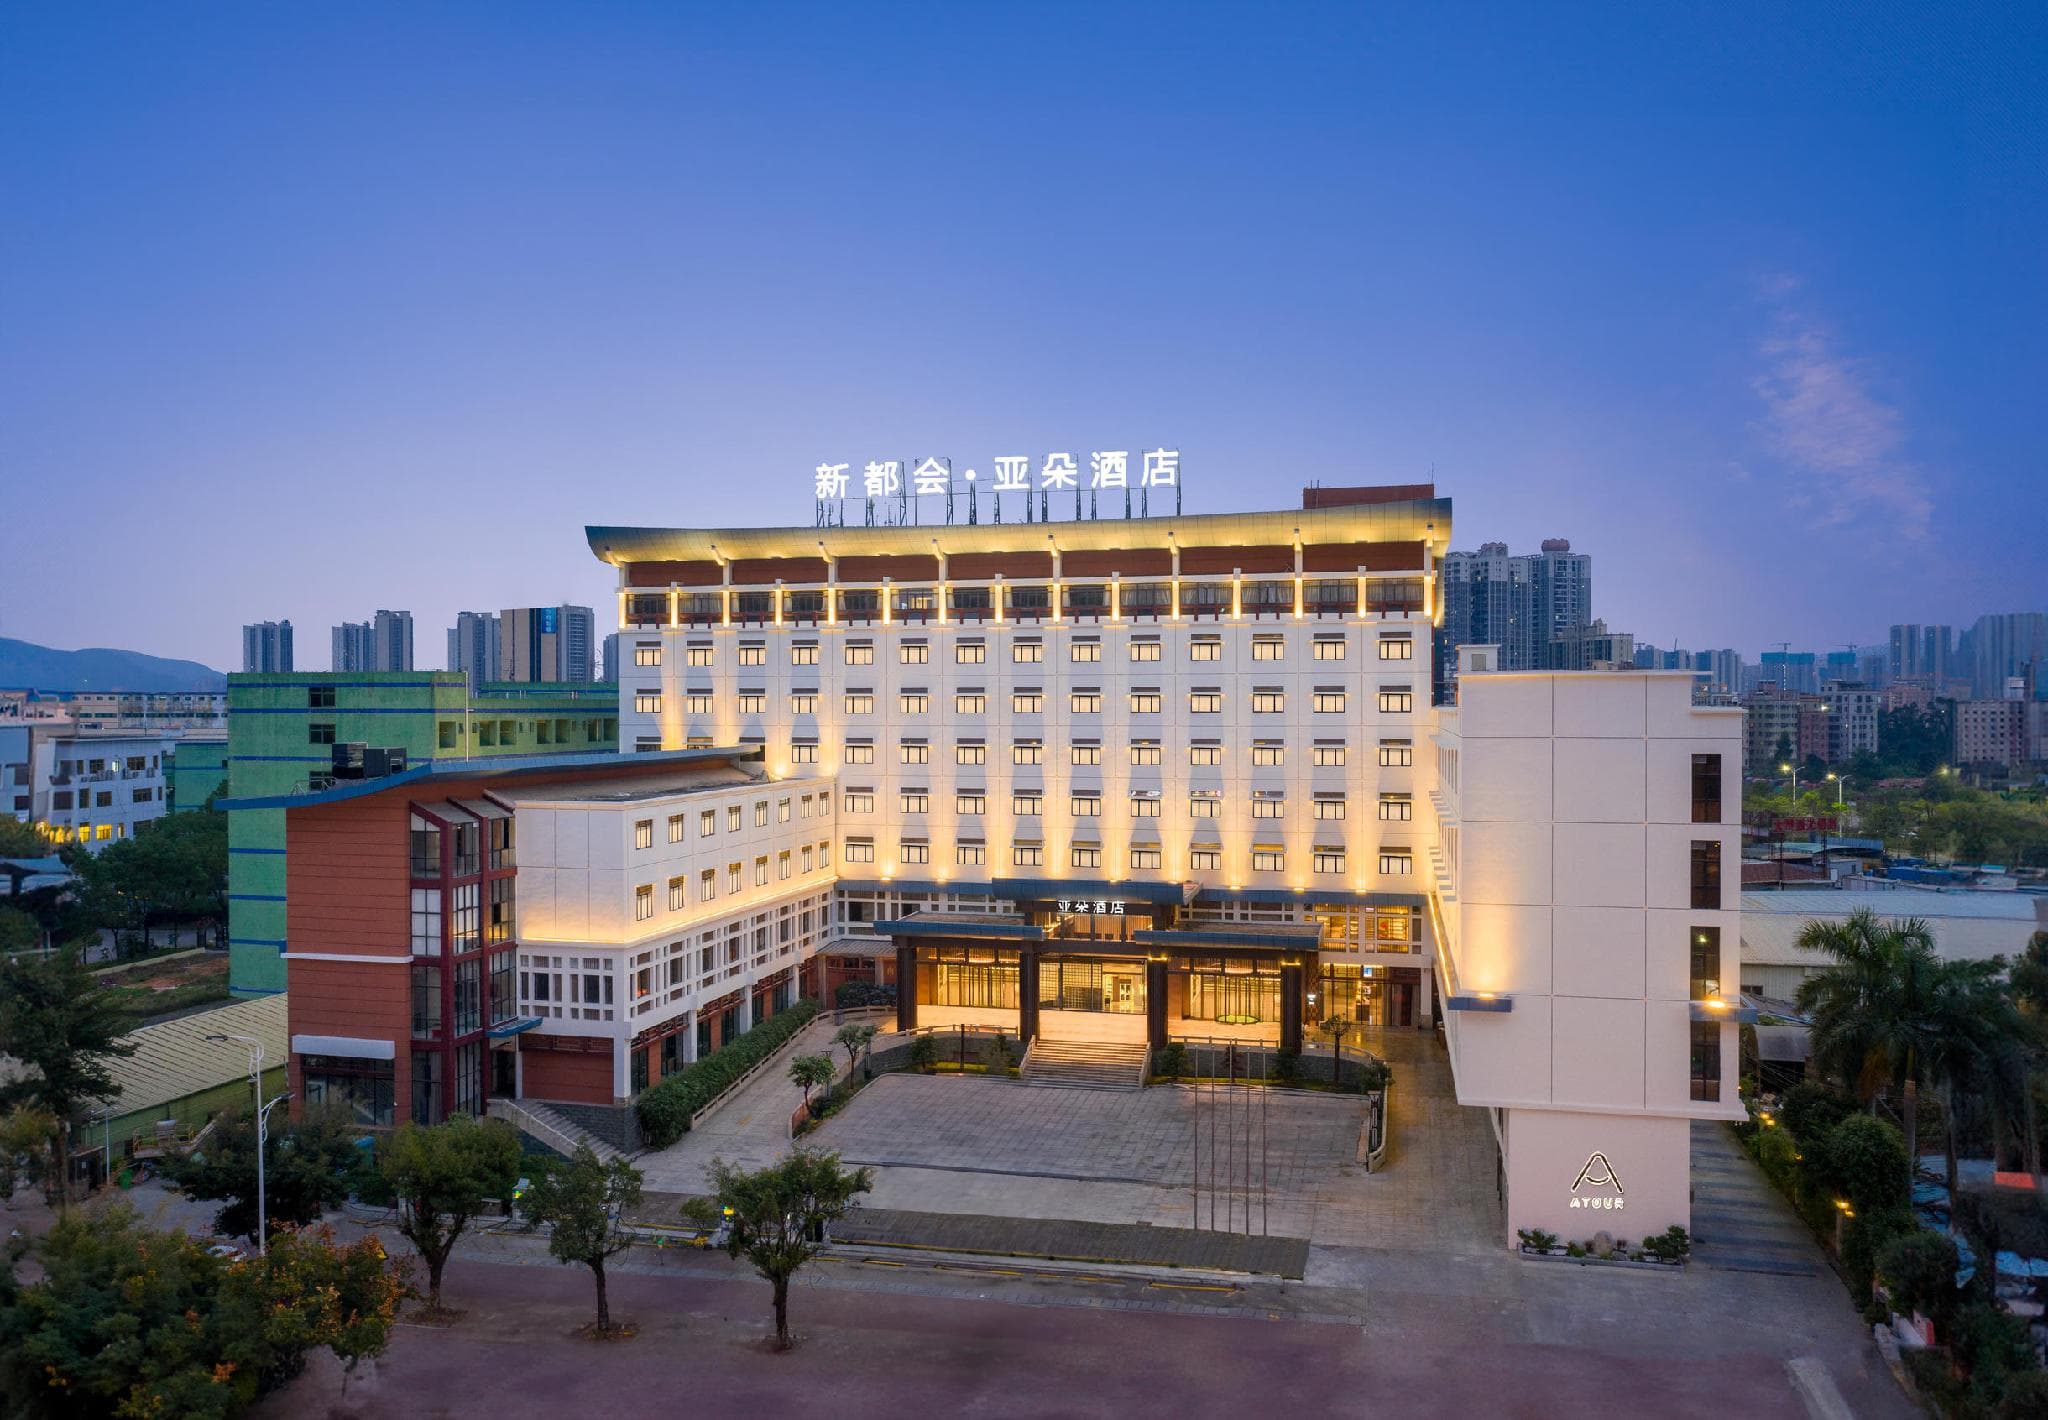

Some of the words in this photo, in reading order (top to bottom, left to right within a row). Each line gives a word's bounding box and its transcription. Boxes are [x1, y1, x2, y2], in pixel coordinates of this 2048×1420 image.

[1057, 900, 1126, 914] 亚朵酒店
[1569, 1197, 1625, 1210] ATOUR
